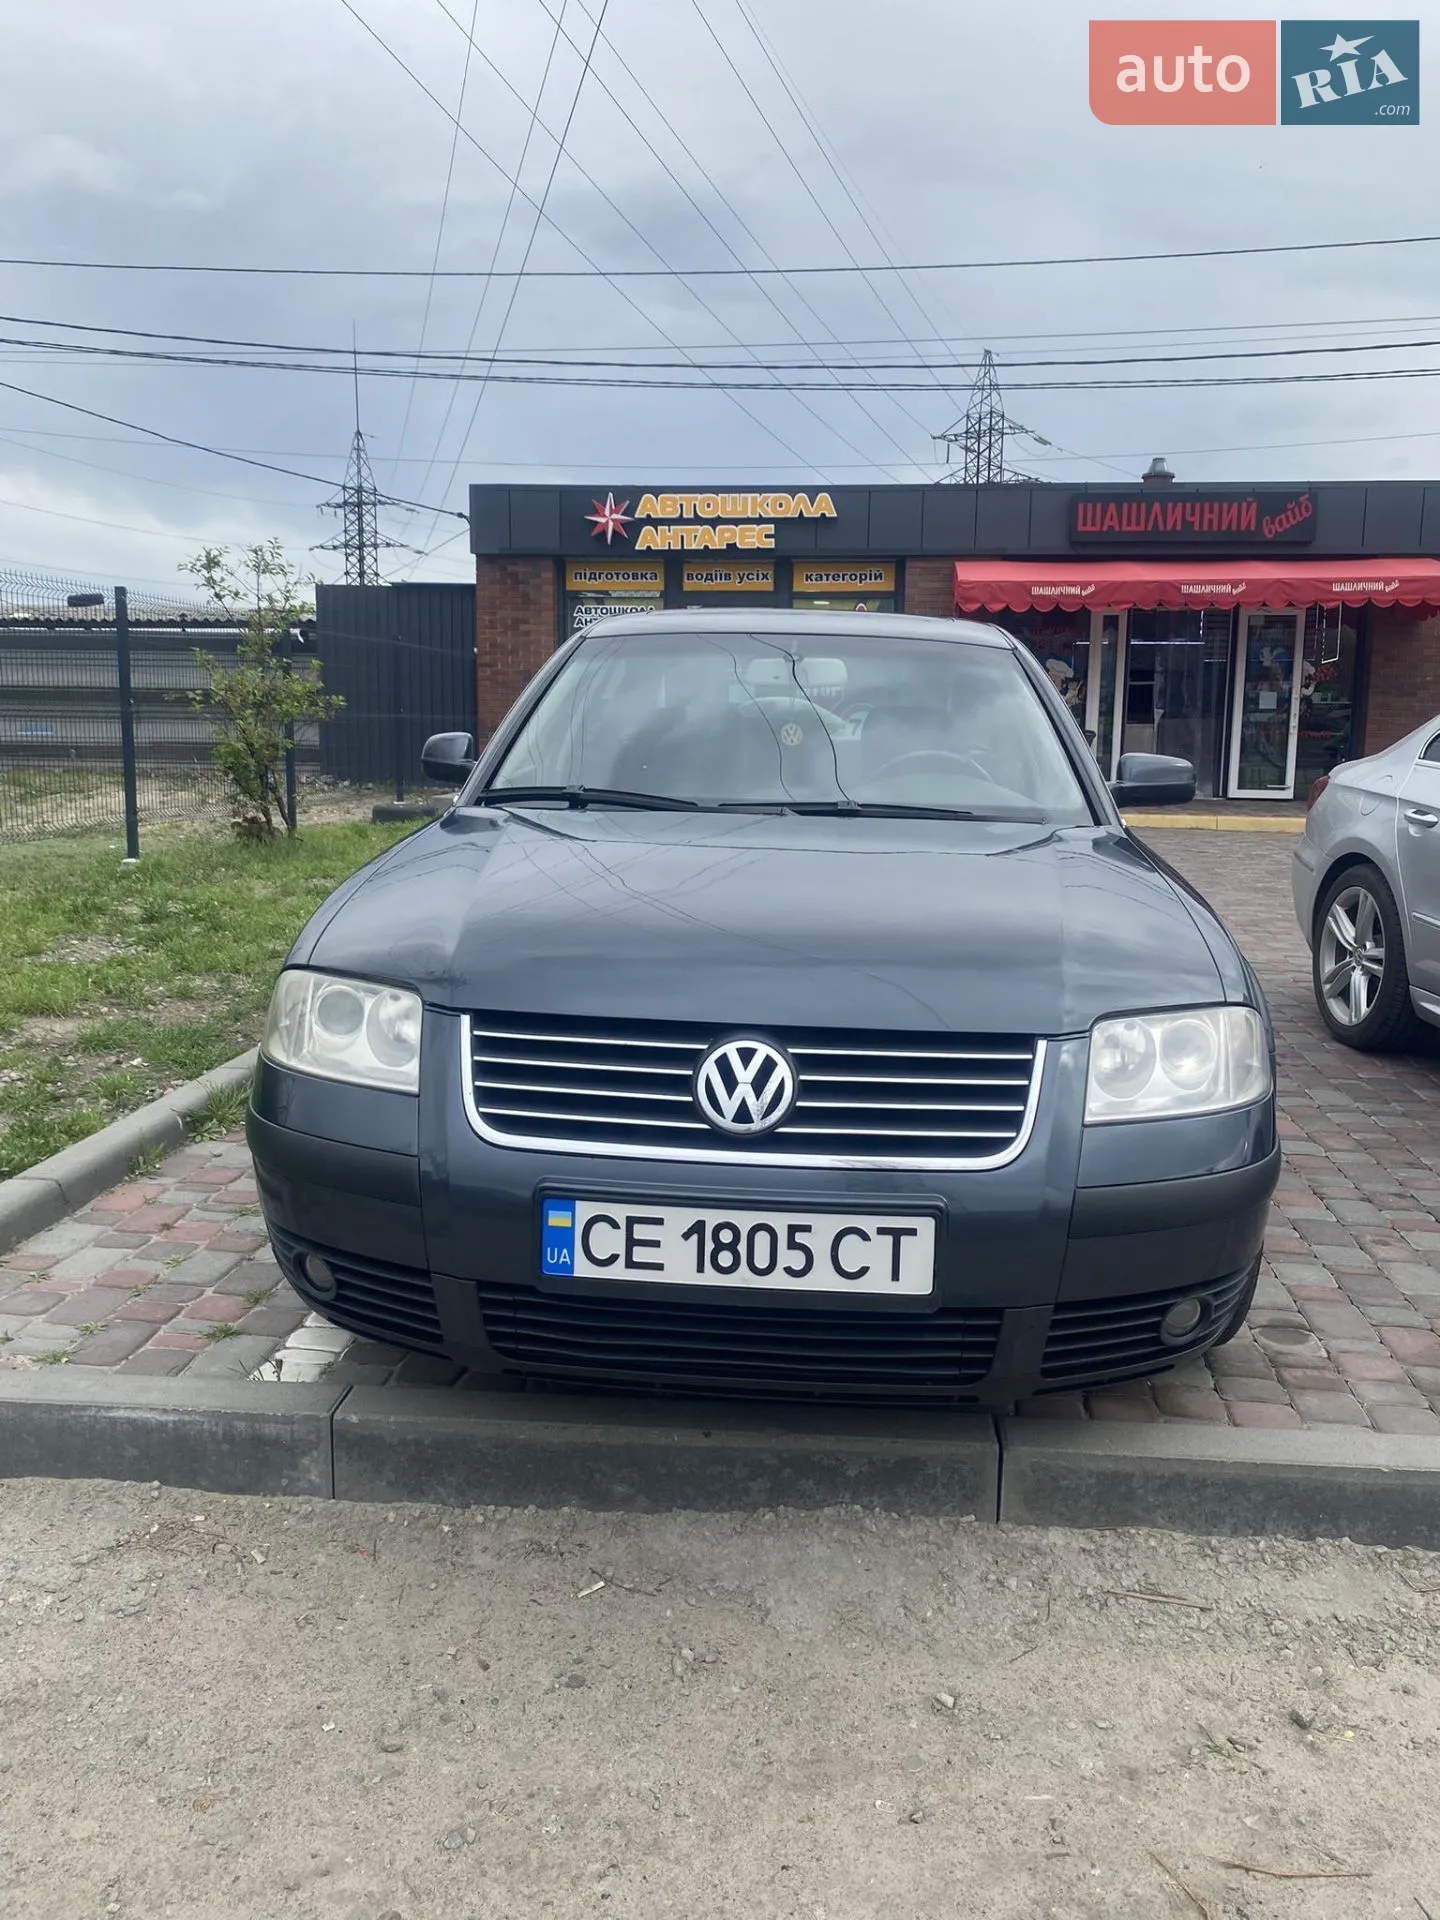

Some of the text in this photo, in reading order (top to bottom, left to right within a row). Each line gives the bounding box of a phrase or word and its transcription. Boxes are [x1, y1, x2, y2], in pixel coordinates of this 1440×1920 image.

[635, 492, 838, 519] АВТОШКОЛА
[1077, 493, 1313, 539] ШАШЛИЧНИЙ вайб
[635, 523, 775, 550] АНТАРЕС
[573, 569, 658, 583] підготовка
[686, 570, 771, 584] водіїв усіх
[804, 569, 884, 584] категорій
[1031, 585, 1081, 596] ШАШЛИЧНИЙ
[1181, 584, 1232, 594] ШАШЛИЧНИЙ
[1332, 581, 1384, 592] ШАШЛИЧНИЙ
[581, 1214, 918, 1282] CE 1805 CT
[546, 1246, 571, 1267] UA
